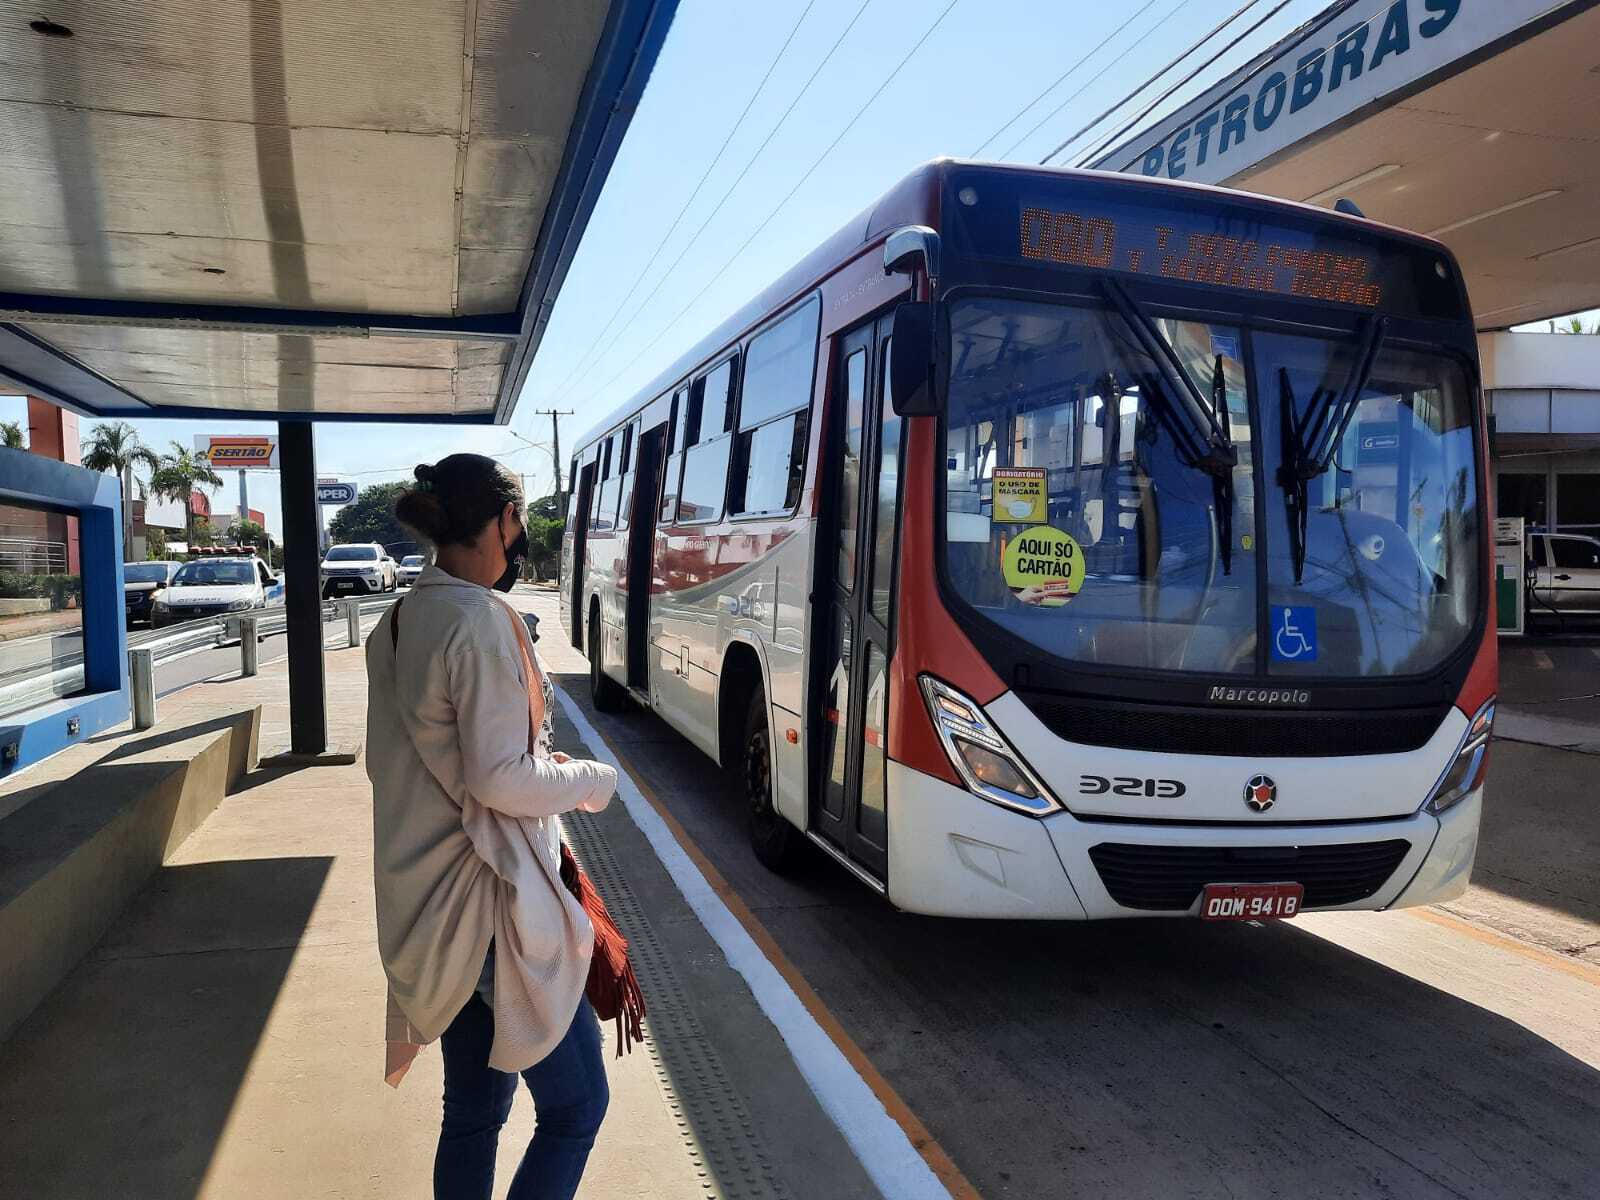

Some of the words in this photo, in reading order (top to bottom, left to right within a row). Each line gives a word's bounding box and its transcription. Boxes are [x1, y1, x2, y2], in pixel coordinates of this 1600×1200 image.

[1142, 0, 1464, 178] PETROBRAS
[1021, 207, 1115, 268] 080
[214, 447, 266, 457] SERTÃO
[1018, 539, 1051, 556] AQUI
[1055, 540, 1073, 558] SÓ
[1017, 557, 1072, 578] CARTÃO
[1210, 686, 1309, 704] Marcopolo
[1079, 775, 1187, 798] 3213
